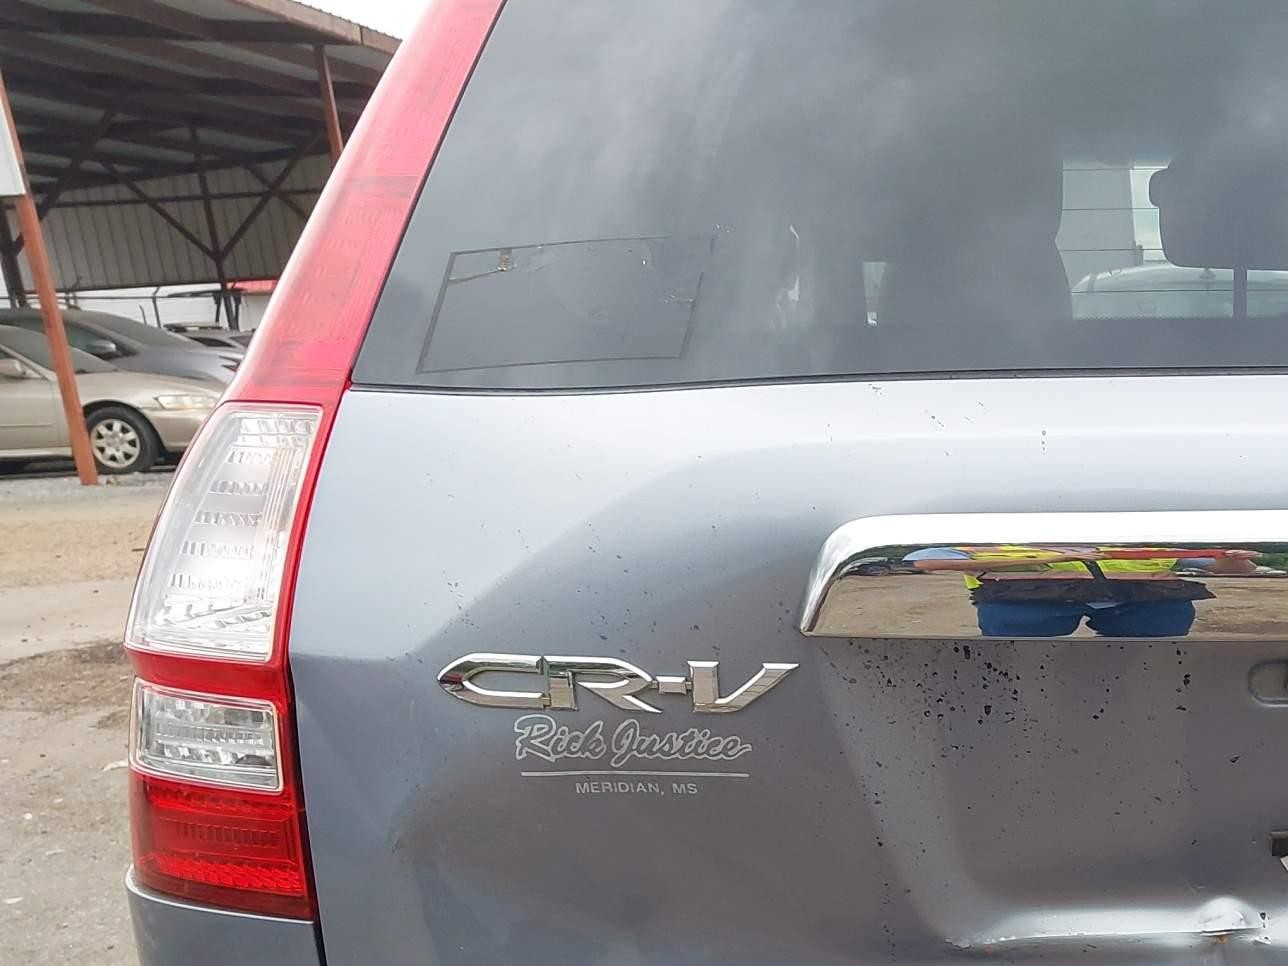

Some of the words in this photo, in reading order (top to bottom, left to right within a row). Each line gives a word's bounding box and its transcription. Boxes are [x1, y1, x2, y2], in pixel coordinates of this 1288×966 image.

[437, 652, 800, 713] CR-V
[514, 713, 607, 763] Rick
[610, 718, 752, 767] Justice
[575, 781, 665, 795] MERIDIAN,
[672, 782, 698, 794] MS
